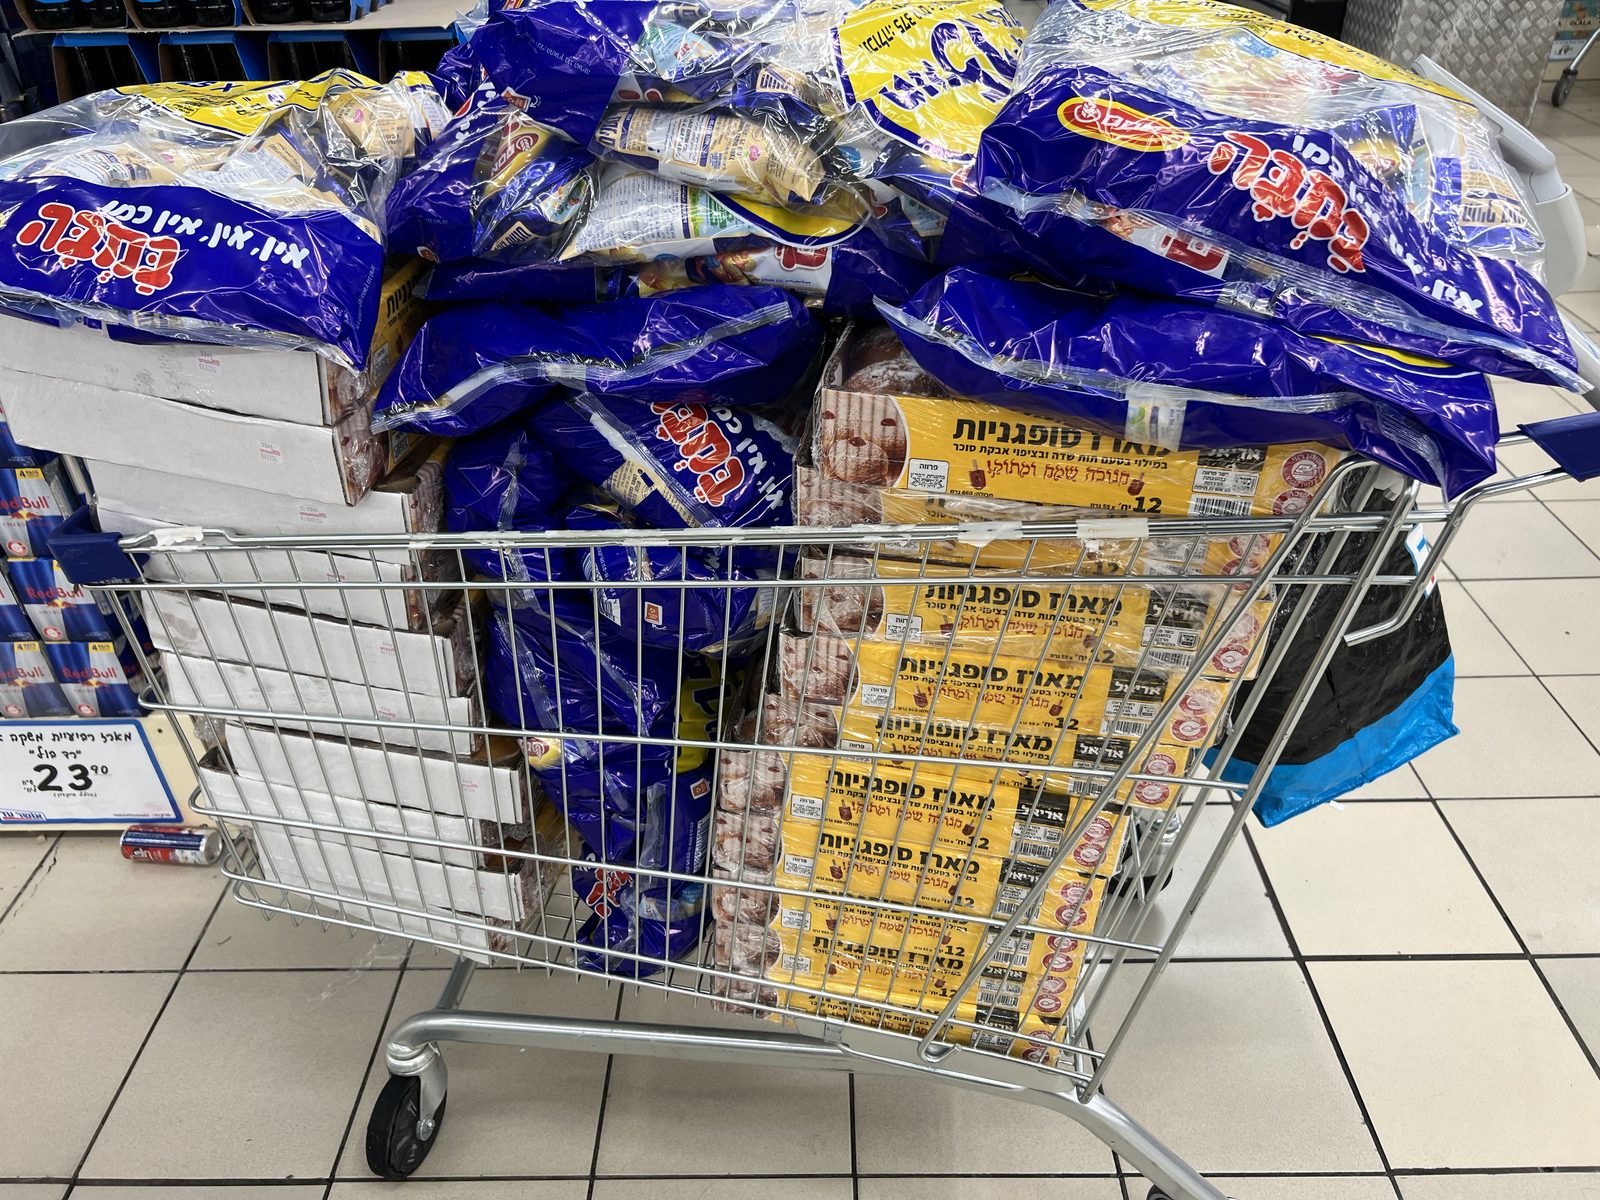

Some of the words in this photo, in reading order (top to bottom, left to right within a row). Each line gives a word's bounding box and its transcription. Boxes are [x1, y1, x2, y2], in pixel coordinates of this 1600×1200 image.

[892, 12, 918, 35] 375
[153, 210, 203, 235] אין
[711, 407, 742, 433] כמ
[952, 418, 1082, 449] סופגניות
[953, 443, 977, 452] סוכר
[979, 446, 1010, 456] אבקת
[1013, 448, 1049, 460] ובציפוי
[1051, 452, 1075, 461] שדה
[1078, 454, 1098, 463] תות
[1101, 456, 1131, 466] בטעם
[919, 463, 939, 471] פרווה
[986, 459, 1037, 478] ומתוק!
[1134, 459, 1168, 470] במילוי
[1043, 463, 1079, 482] שמח
[1085, 466, 1130, 487] חנוכה
[0, 496, 19, 509] ed
[22, 496, 49, 509] Bull
[1132, 496, 1162, 513] 12
[25, 588, 55, 599] Red
[58, 588, 84, 598] Bull
[925, 584, 1040, 607] סופגניות
[925, 601, 946, 610] סוכר
[950, 603, 976, 611] אבת
[1049, 592, 1122, 616] מארז
[979, 606, 1010, 616] בציפוי
[1088, 617, 1119, 627] בילוי
[0, 668, 15, 678] ed
[17, 667, 44, 678] Bull
[62, 668, 89, 678] Red
[92, 667, 117, 678] Bull
[900, 657, 1008, 682] סופגניות
[921, 676, 948, 685] אקת
[1016, 669, 1084, 691] מארז
[1027, 688, 1052, 697] בטע
[1054, 717, 1079, 730] 12
[10, 731, 44, 746] משקה
[52, 732, 95, 742] רביעיית
[101, 731, 132, 743] מארז
[987, 729, 1052, 752] מארז
[1079, 743, 1124, 759] אראל
[33, 763, 93, 792] 23
[826, 769, 925, 798] סופגניות
[826, 786, 844, 794] סוכ
[847, 789, 871, 799] בקת
[932, 788, 995, 811] מארז
[940, 806, 964, 816] בטע
[966, 810, 992, 821] בילוי
[1021, 804, 1064, 821] אריאל
[820, 833, 912, 861] סופגניות
[967, 836, 990, 849] 12
[920, 851, 980, 875] מארז
[887, 870, 911, 883] שמ
[833, 904, 855, 912] אבת
[945, 945, 966, 957] 12
[908, 950, 964, 970] מארז
